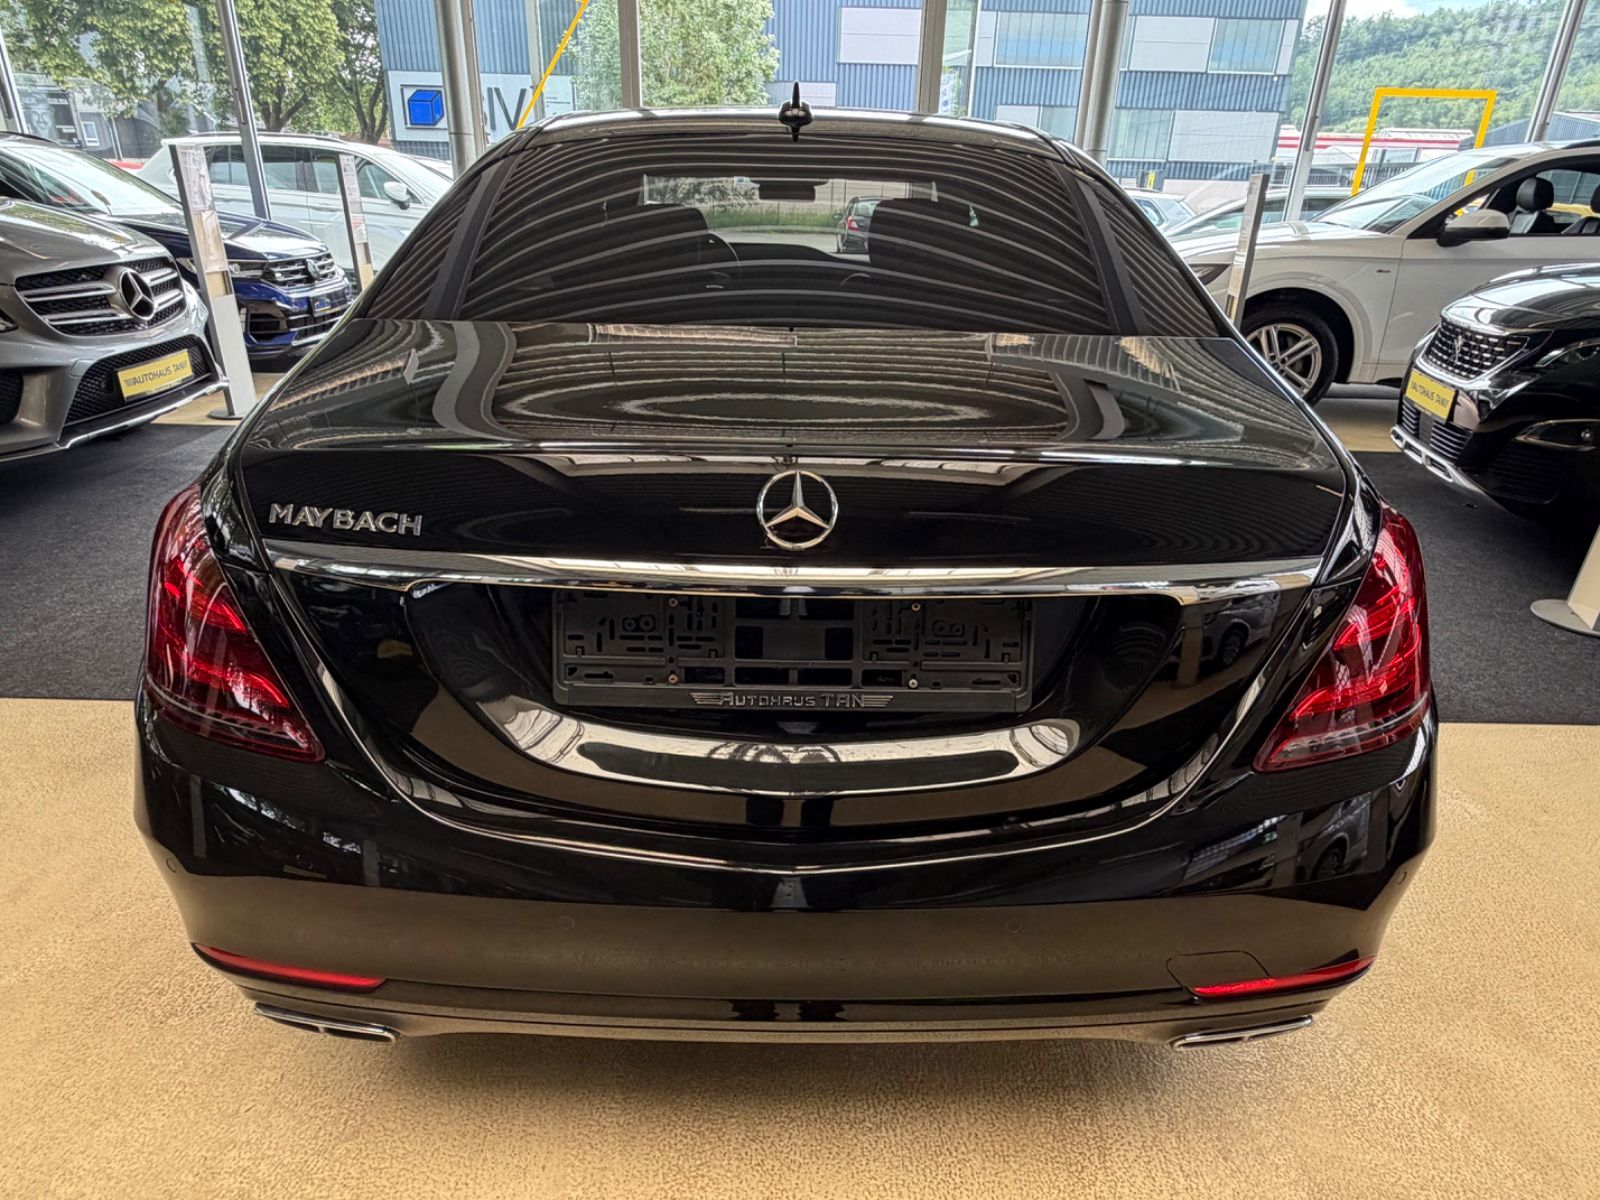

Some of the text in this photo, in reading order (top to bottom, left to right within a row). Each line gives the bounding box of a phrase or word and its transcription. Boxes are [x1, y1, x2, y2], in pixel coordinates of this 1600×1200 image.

[483, 87, 527, 131] IV
[134, 366, 172, 384] AUTOHAUS
[268, 503, 423, 536] MAYBACH
[719, 692, 865, 708] AUTOHAUS TAN
